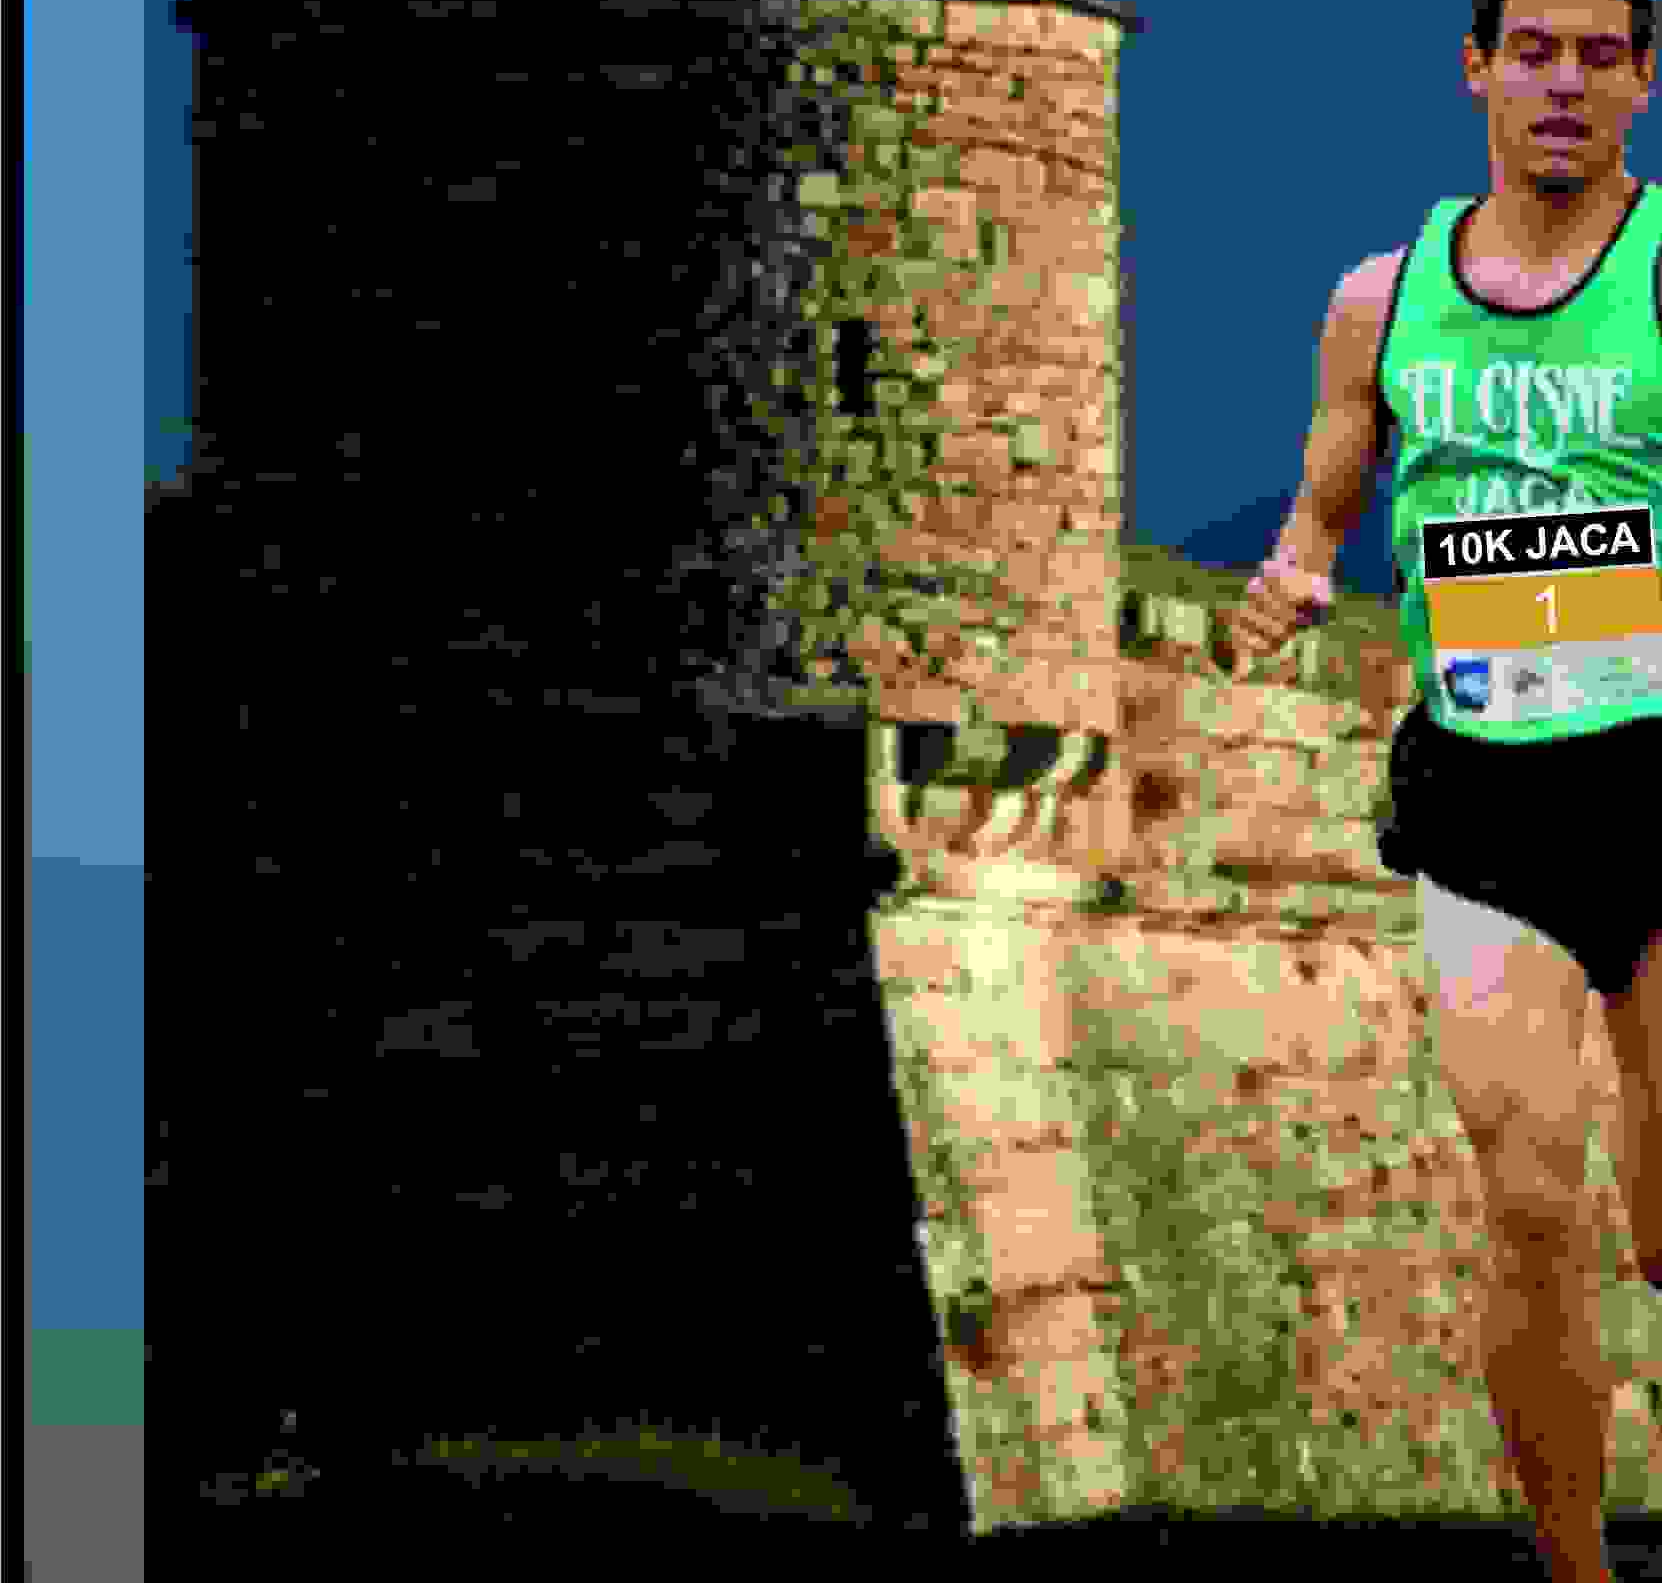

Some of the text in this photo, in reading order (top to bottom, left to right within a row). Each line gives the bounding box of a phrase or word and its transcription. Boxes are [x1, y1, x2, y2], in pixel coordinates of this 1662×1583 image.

[1439, 521, 1640, 566] 10K JACA
[1536, 584, 1560, 634] 1
